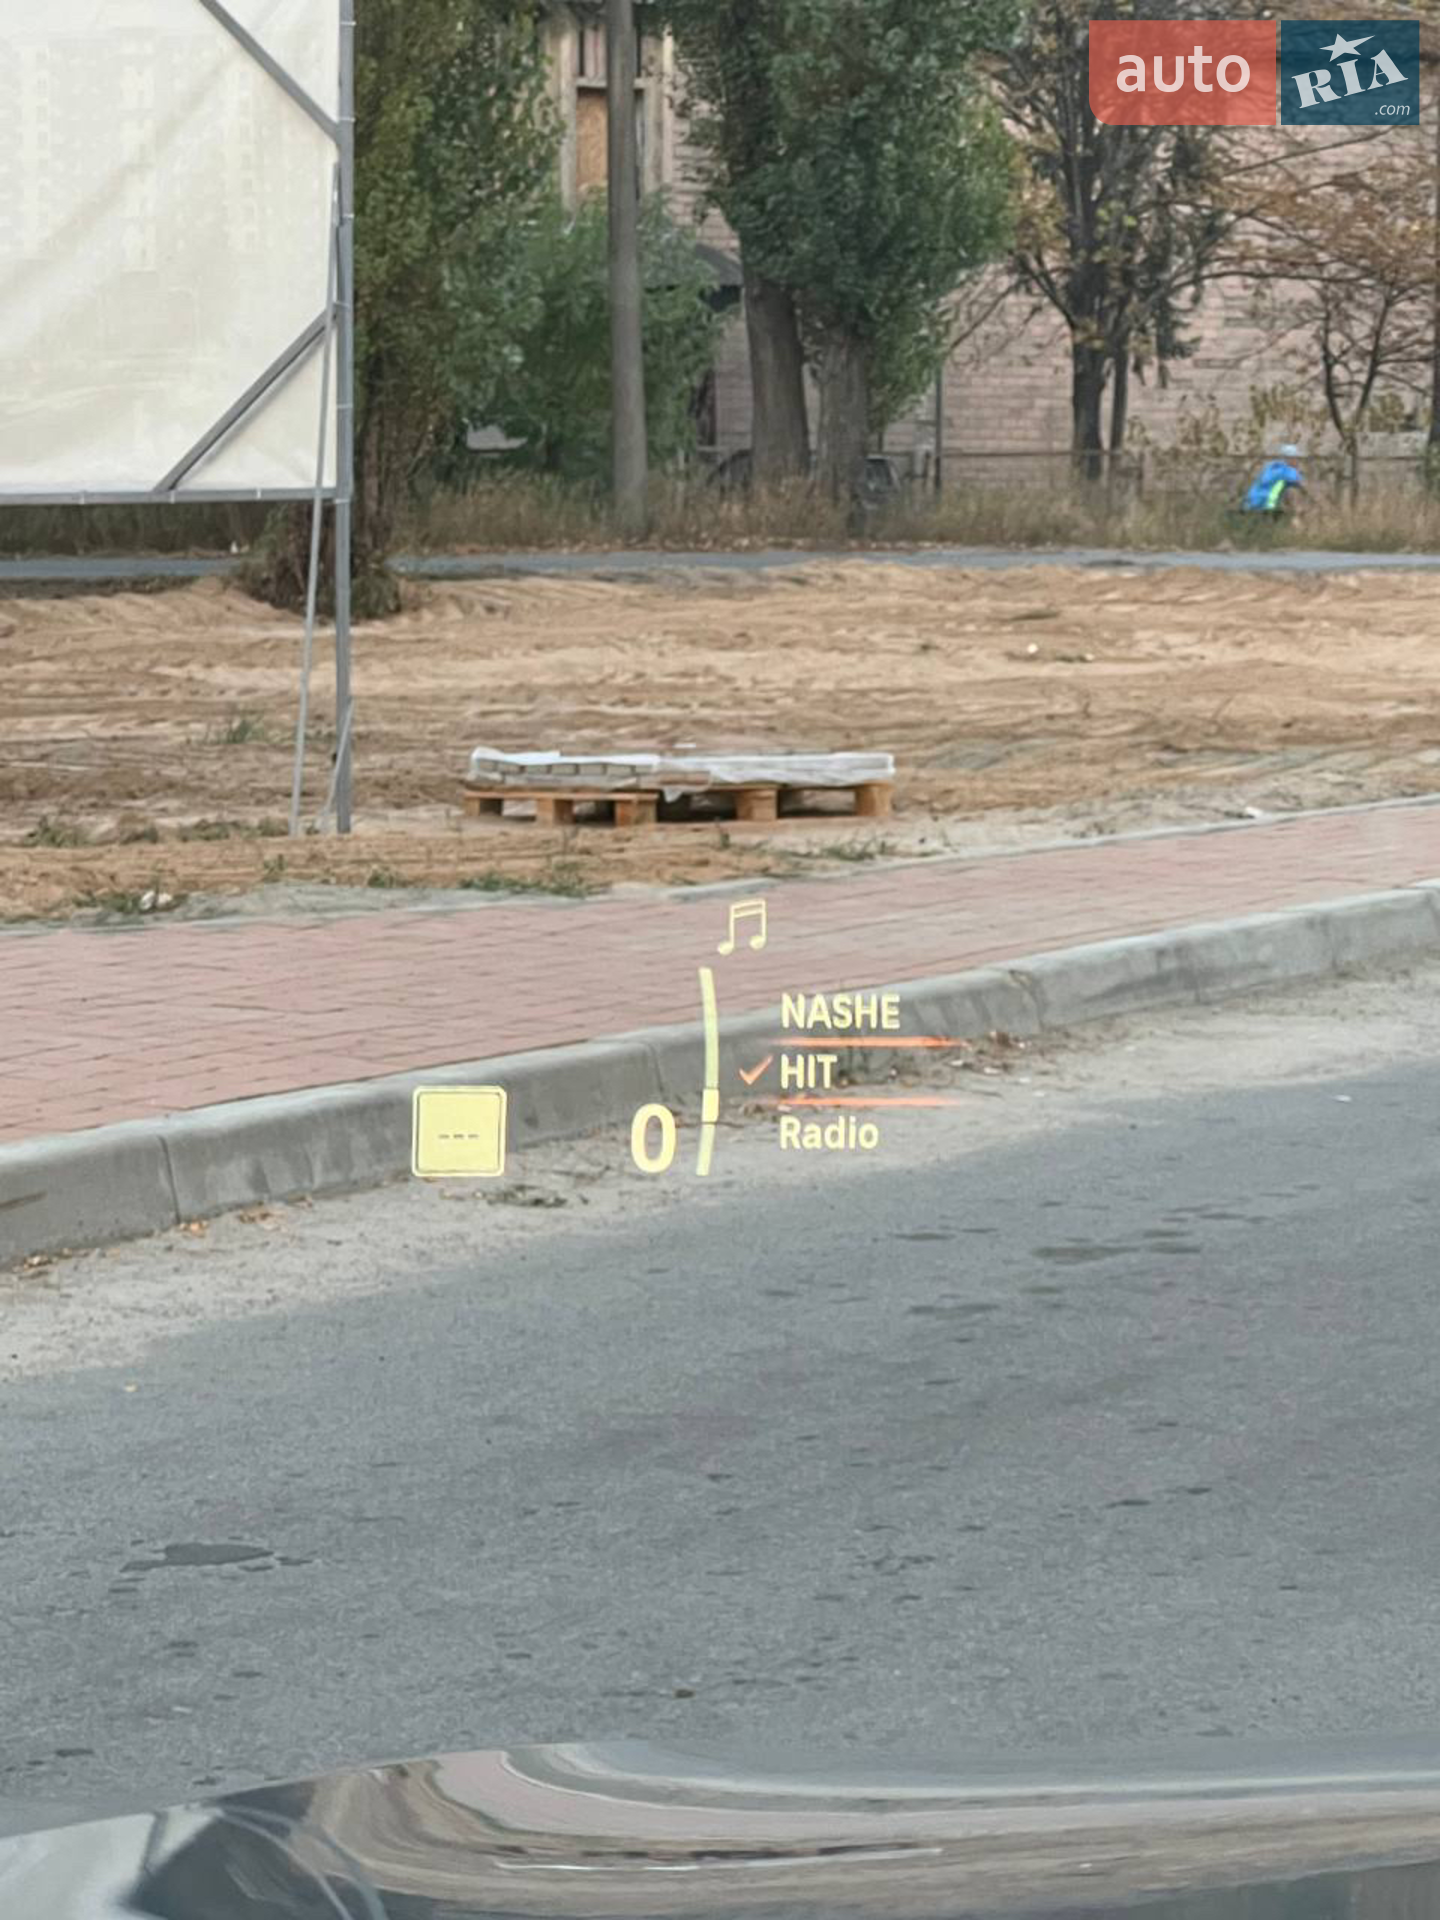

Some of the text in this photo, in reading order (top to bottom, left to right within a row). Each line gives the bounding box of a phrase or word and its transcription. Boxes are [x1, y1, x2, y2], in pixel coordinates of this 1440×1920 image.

[780, 993, 901, 1029] NASHE
[780, 1054, 838, 1089] HIT
[631, 1103, 676, 1173] 0
[779, 1115, 879, 1150] Radio
